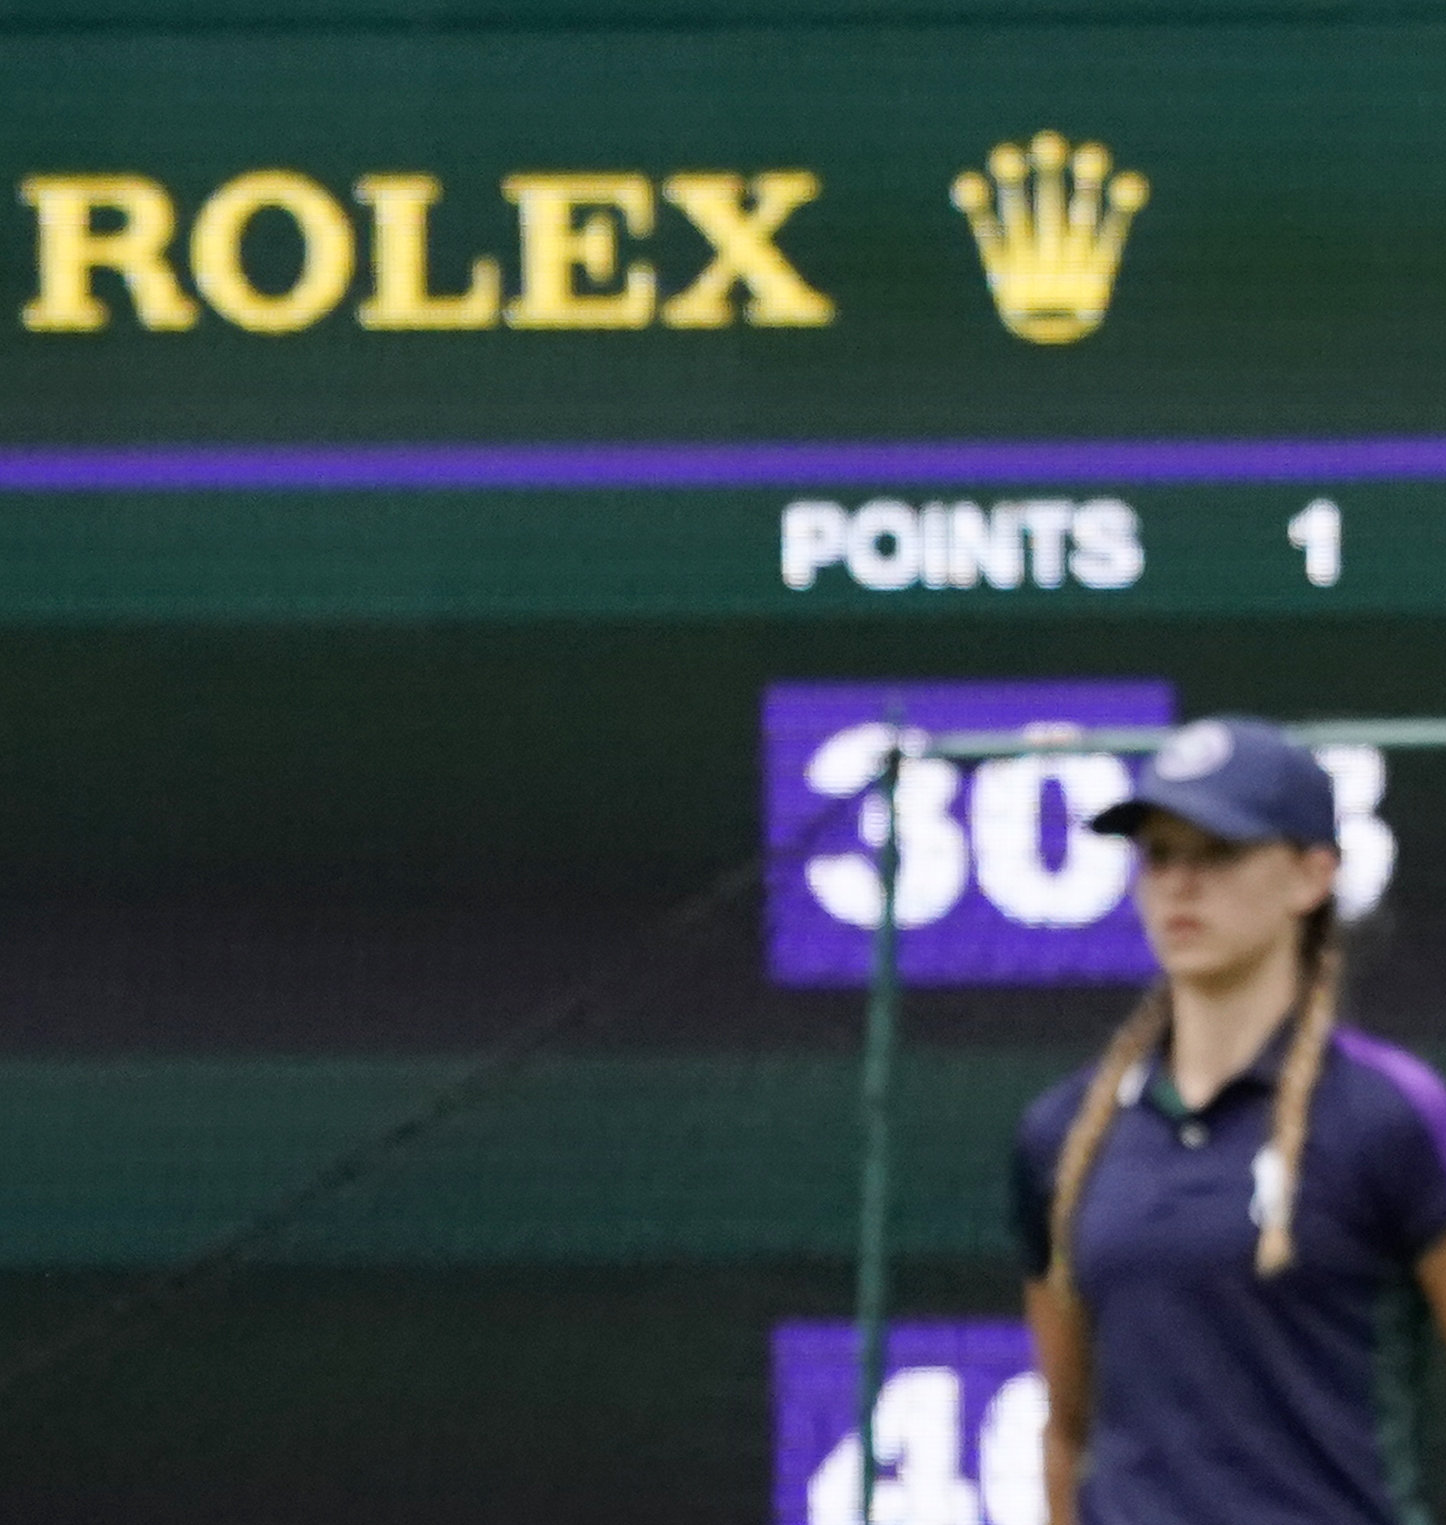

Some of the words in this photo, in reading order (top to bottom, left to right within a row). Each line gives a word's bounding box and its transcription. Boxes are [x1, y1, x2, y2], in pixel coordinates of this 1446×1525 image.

[22, 170, 834, 333] ROLEX
[781, 499, 1144, 590] POINTS
[1287, 499, 1342, 587] 1
[805, 722, 1137, 929] 30
